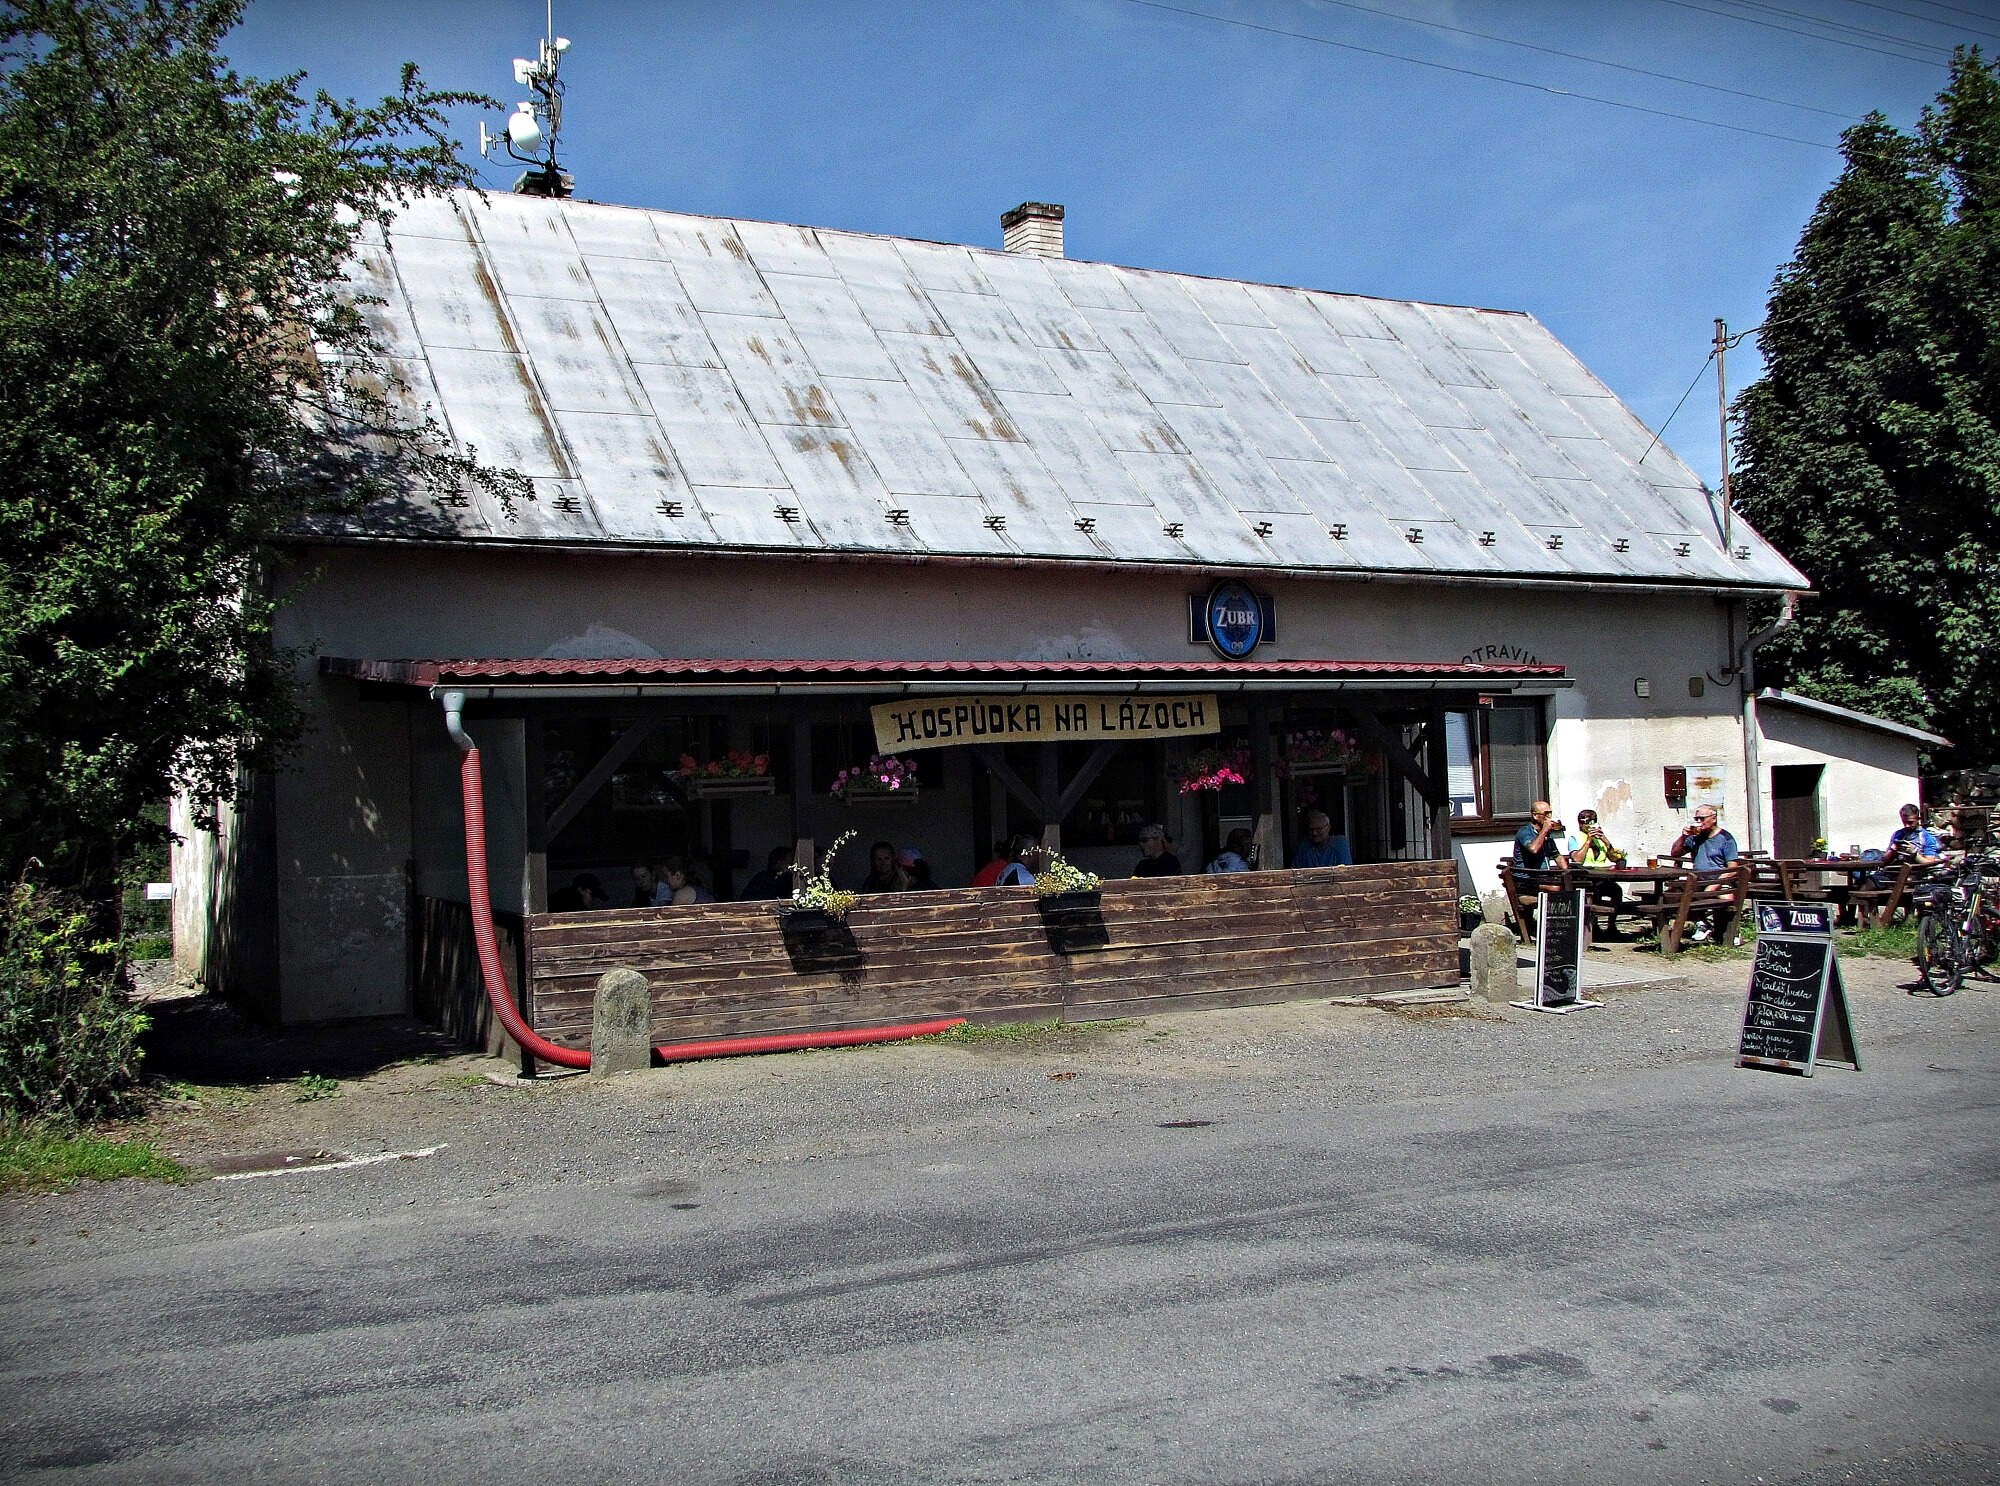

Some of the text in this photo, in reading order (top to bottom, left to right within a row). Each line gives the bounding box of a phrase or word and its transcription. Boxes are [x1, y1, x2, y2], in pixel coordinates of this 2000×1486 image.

[1215, 606, 1255, 628] ZUBR
[890, 698, 1205, 743] HOSPŮDKA NA LÁZOCH
[1789, 910, 1820, 926] ZUBR
